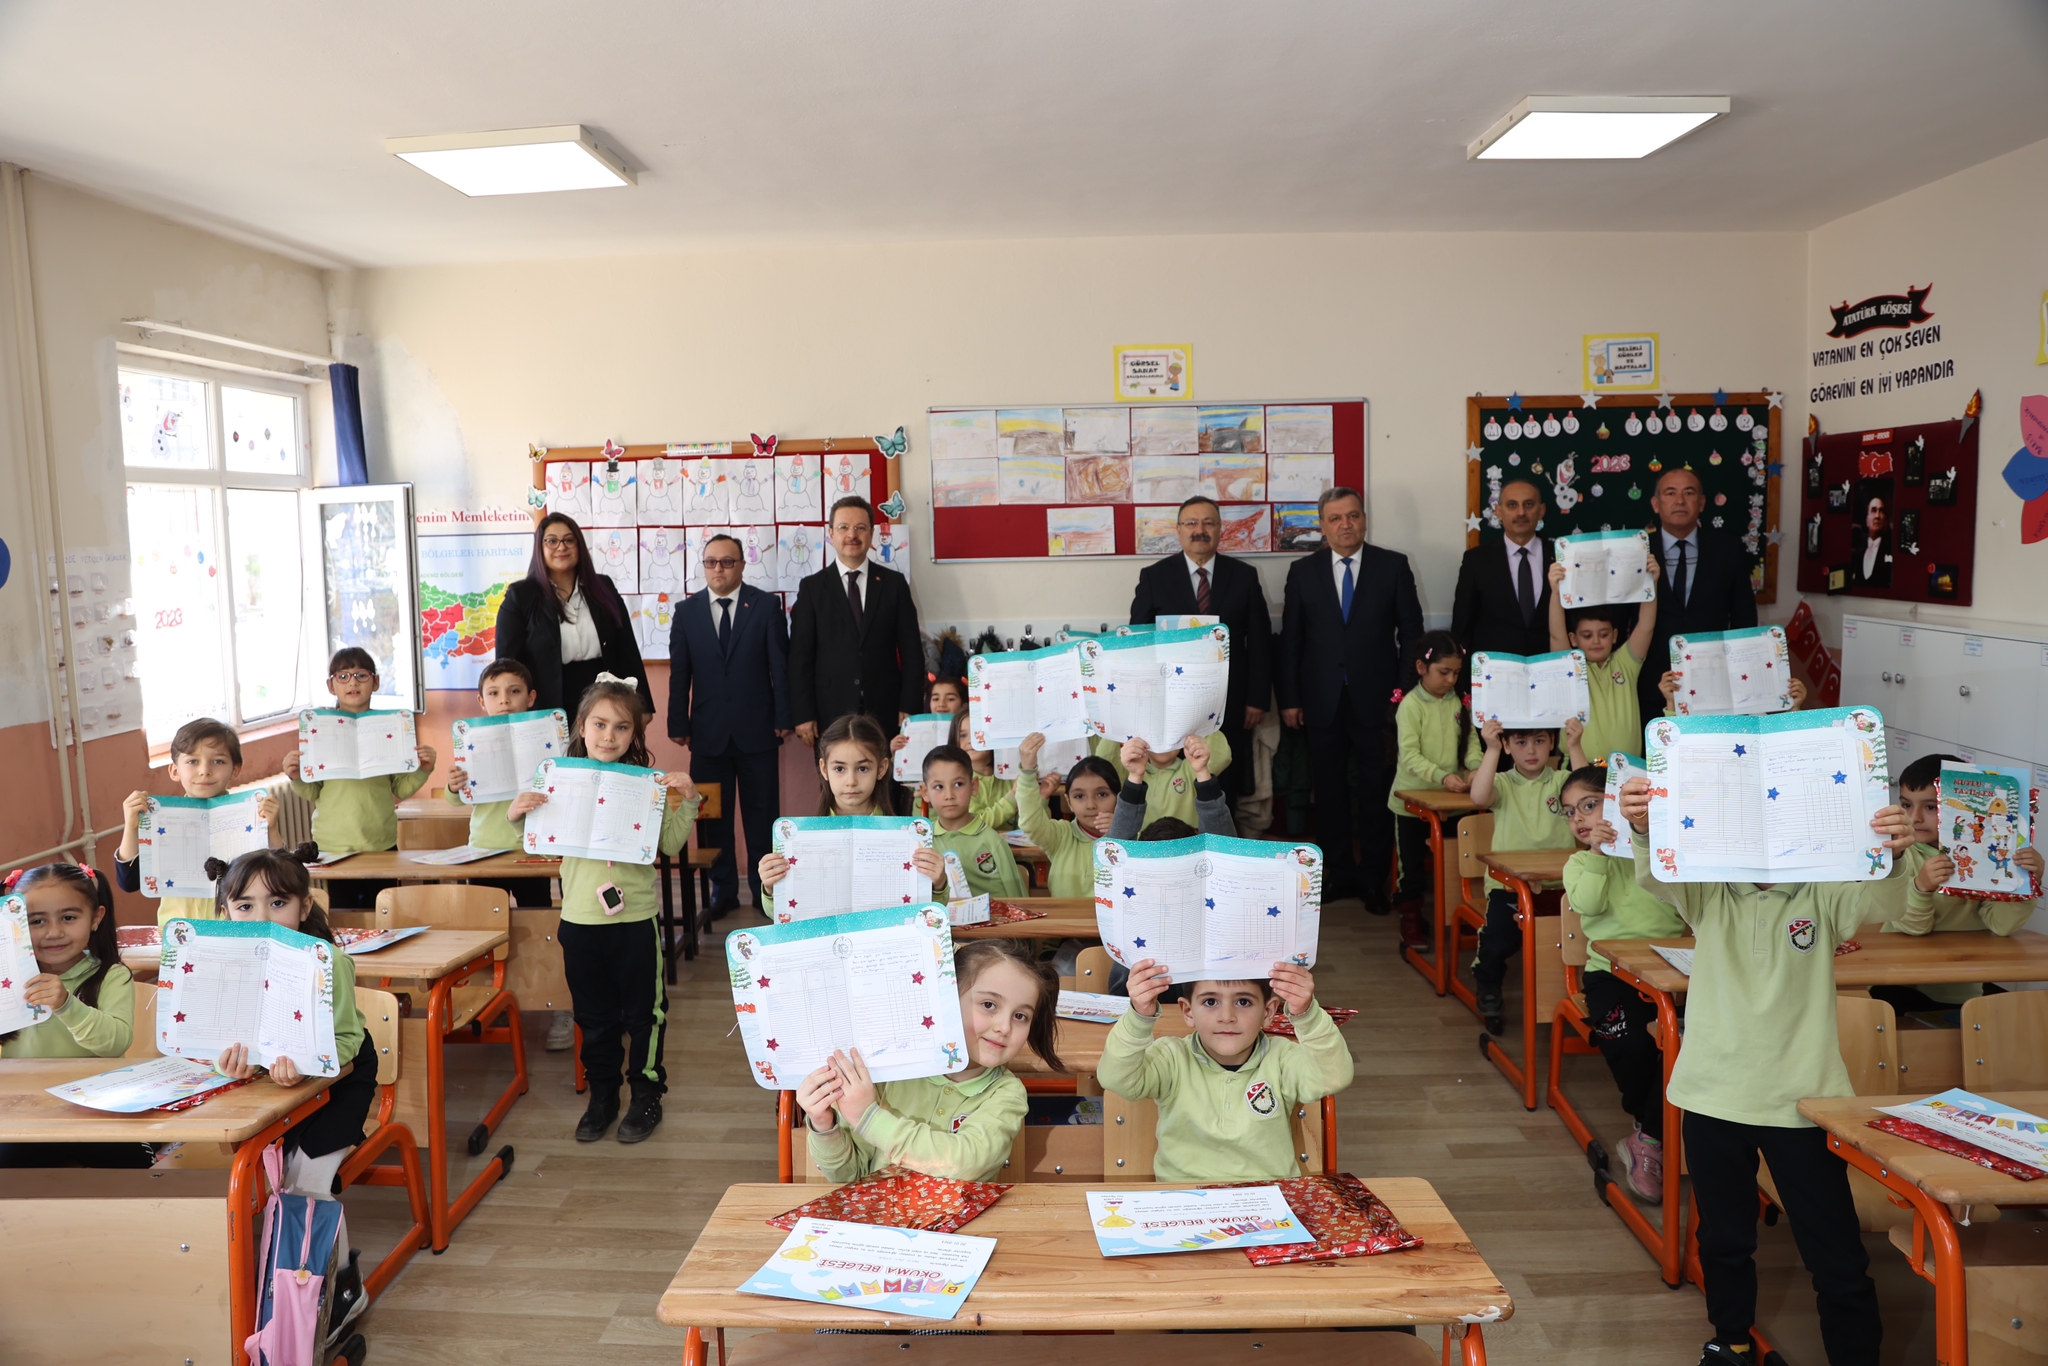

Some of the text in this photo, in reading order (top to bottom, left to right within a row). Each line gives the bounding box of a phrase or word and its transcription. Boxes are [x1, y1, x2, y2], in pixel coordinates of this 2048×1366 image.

[1842, 300, 1912, 327] ATATÜRK KÖŞESİ
[1812, 324, 1941, 367] VATANINI EN ÇOK SEVEN
[1810, 359, 1954, 403] GÖREVİNİ EN İYİ YAPANDIR
[1487, 416, 1750, 438] MUTLU YILLAR
[1591, 454, 1631, 473] 2023
[416, 511, 530, 523] enim Memleketim
[421, 548, 523, 558] BÖLGELER HARİTASI
[155, 607, 183, 629] 2023
[1953, 779, 1982, 788] MUTLU
[1139, 1215, 1262, 1229] OKUMA BELGESİ
[818, 1258, 943, 1280] OKUMA BELGESİ
[846, 1283, 958, 1296] BAŞARI
